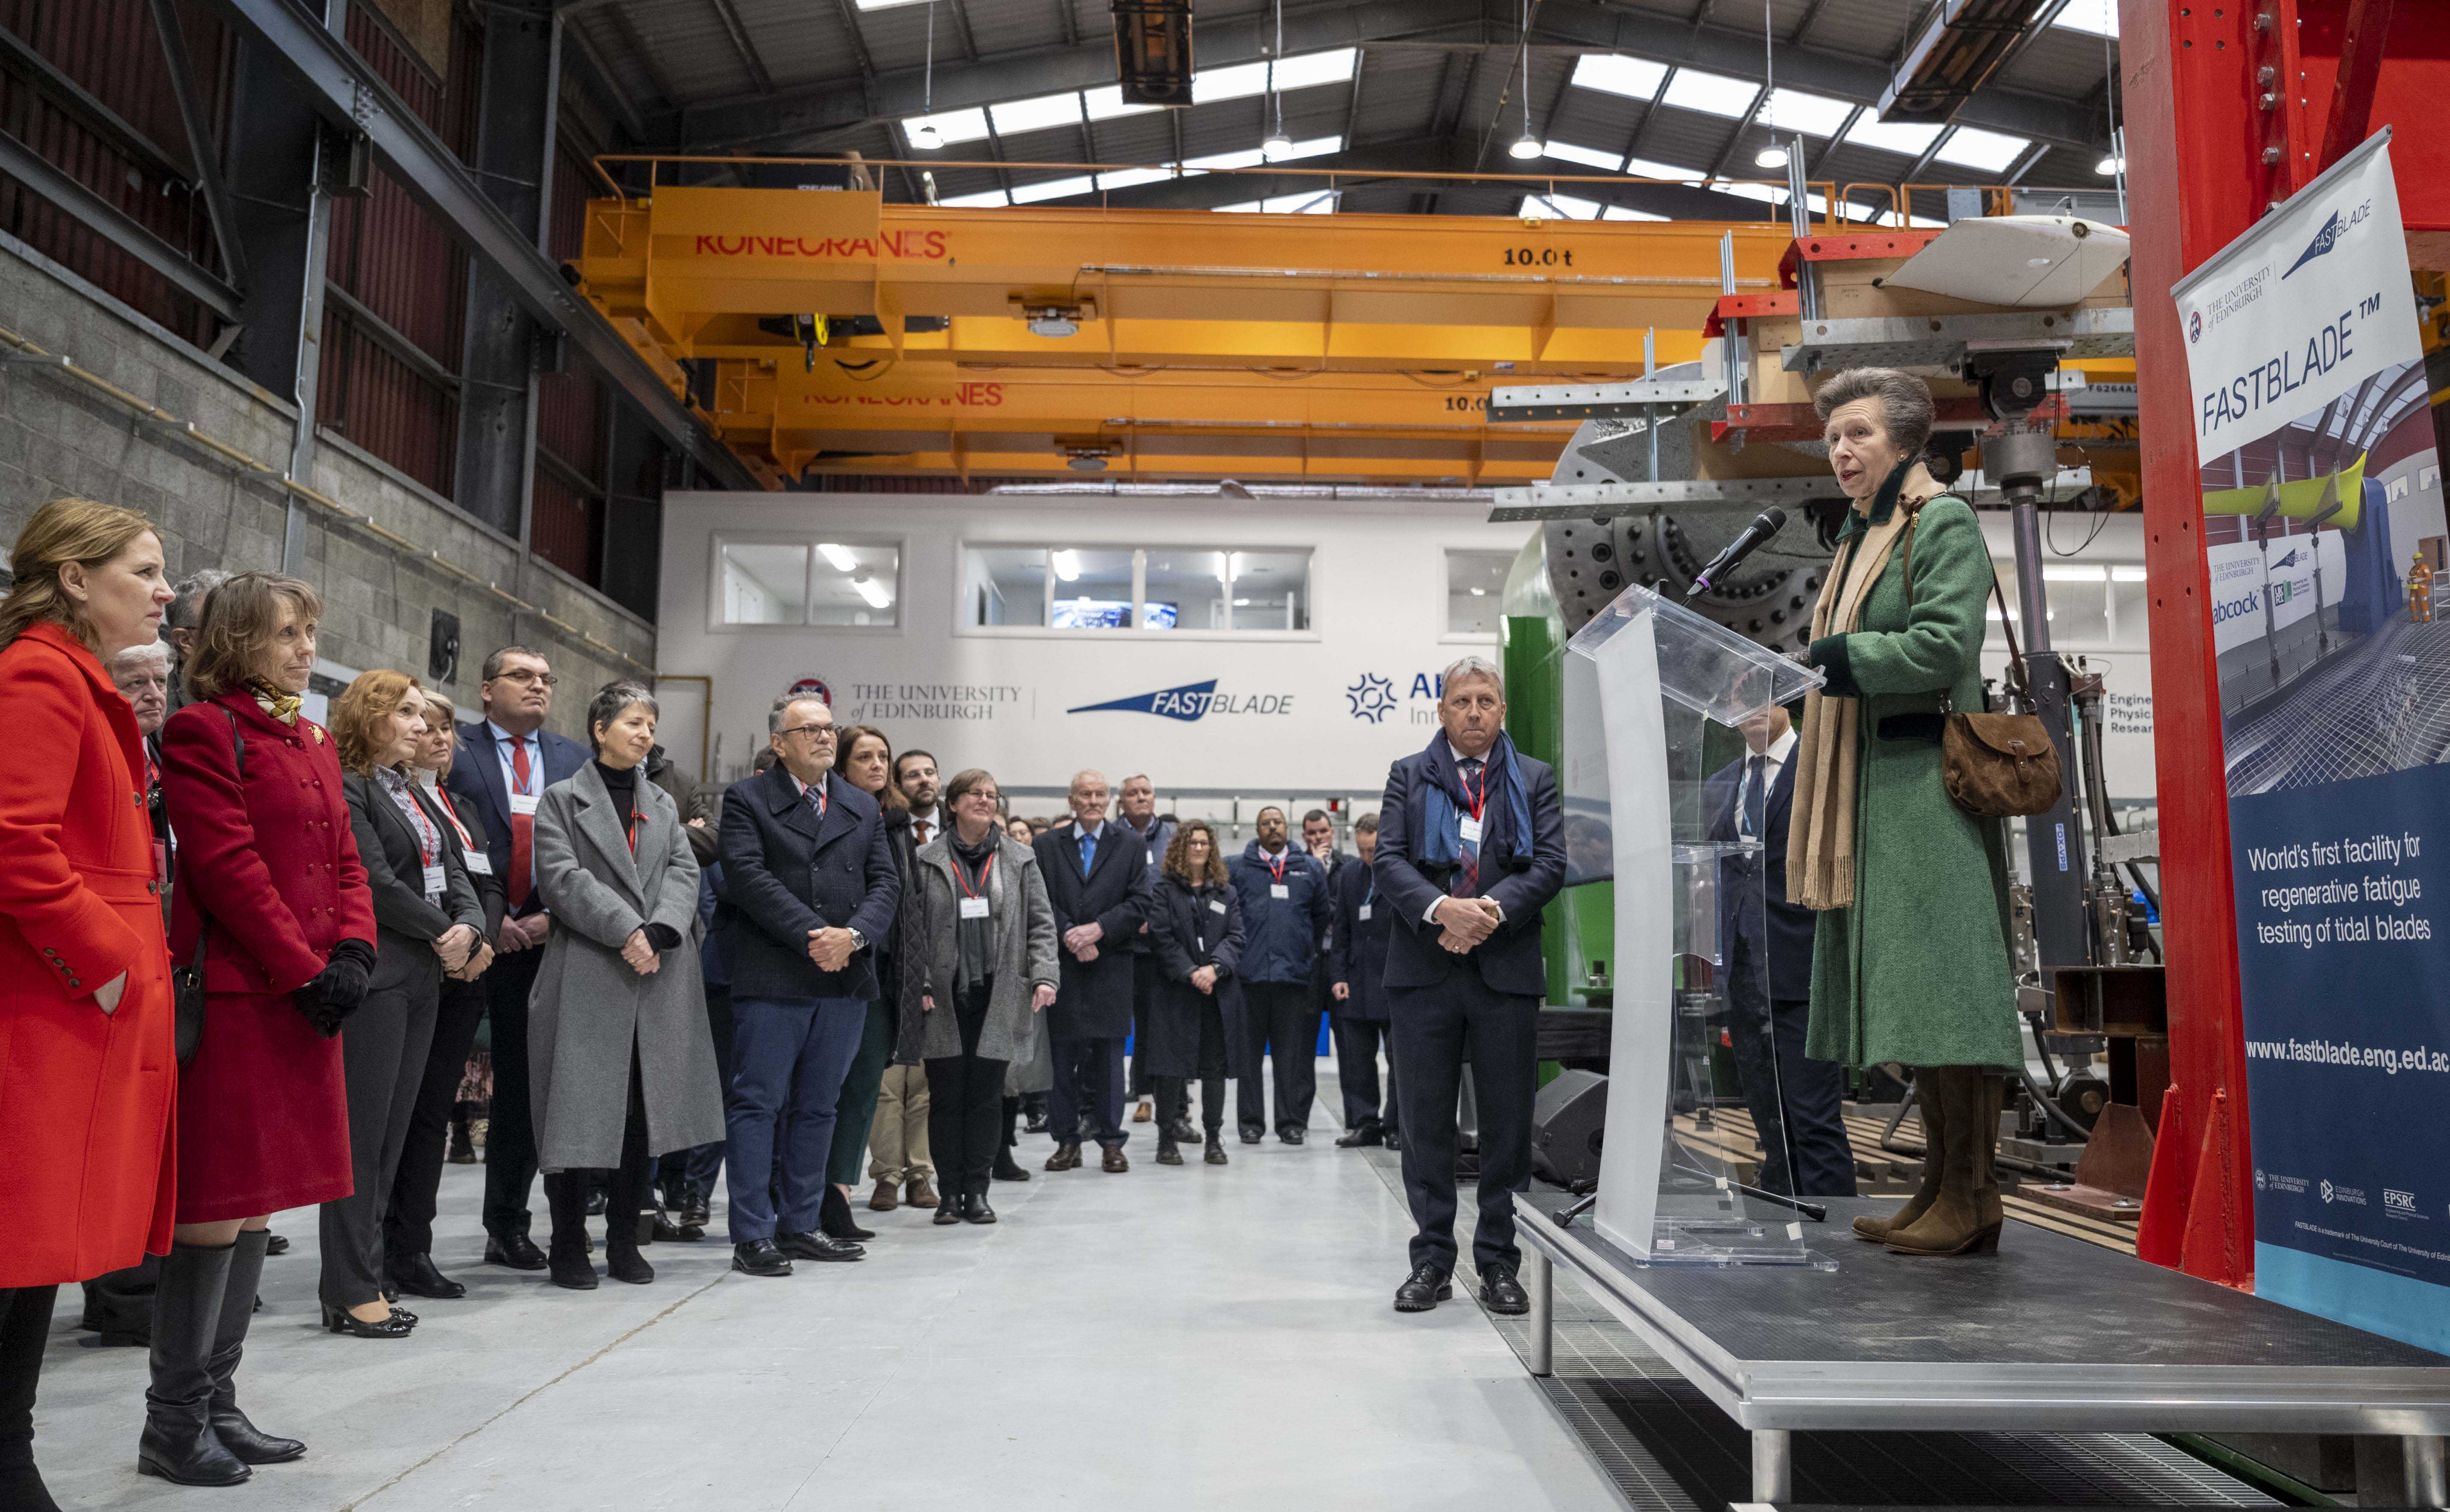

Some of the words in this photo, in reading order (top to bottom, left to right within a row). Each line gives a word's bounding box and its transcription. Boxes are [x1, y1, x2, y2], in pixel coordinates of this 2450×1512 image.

[2315, 198, 2371, 255] FASTBLADE
[695, 231, 946, 259] KONECRANES
[1504, 249, 1557, 266] 10.0
[1563, 250, 1572, 267] t
[2207, 297, 2223, 315] THE
[2225, 264, 2271, 304] UNIVERSITY
[2208, 314, 2215, 333] of
[2216, 285, 2262, 324] EDINBURGH
[2213, 563, 2225, 573] THE
[2226, 558, 2260, 571] UNIVERSITY
[2286, 551, 2308, 565] FASTBLADE
[2215, 573, 2219, 585] of
[2219, 567, 2254, 581] EDINBURGH
[852, 684, 894, 701] THE
[900, 685, 1021, 702] UNIVERSITY
[2110, 693, 2152, 707] Engine
[851, 701, 869, 723] of
[872, 702, 993, 720] EDINBURGH
[1150, 692, 1294, 715] FASTBLADE
[2110, 707, 2151, 721] Physic
[2111, 723, 2152, 733] Resear
[2056, 825, 2066, 870] FOX-VPS
[2247, 844, 2308, 871] World's
[2312, 841, 2341, 866] first
[2344, 835, 2401, 866] facility
[2404, 832, 2420, 858] for
[2262, 878, 2359, 913] regenerative
[2363, 874, 2421, 907] fatigue
[2257, 919, 2312, 949] testing
[2316, 917, 2331, 942] of
[2334, 916, 2370, 942] tidal
[2375, 914, 2431, 941] blades
[2268, 1174, 2280, 1182] THE
[2280, 1176, 2310, 1187] UNIVERSITY
[2269, 1182, 2274, 1190] of
[2274, 1182, 2304, 1193] EDINBURGH
[2335, 1185, 2364, 1196] EDINBURGH
[2336, 1193, 2367, 1205] INNOVATIONS
[2383, 1191, 2416, 1209] EPSRC
[2295, 1221, 2317, 1232] FASTBLADE
[2324, 1228, 2345, 1238] trademark
[2351, 1233, 2359, 1242] The
[2360, 1235, 2380, 1247] University
[2380, 1240, 2392, 1249] Court
[2398, 1243, 2407, 1252] The
[2407, 1246, 2430, 1259] University
